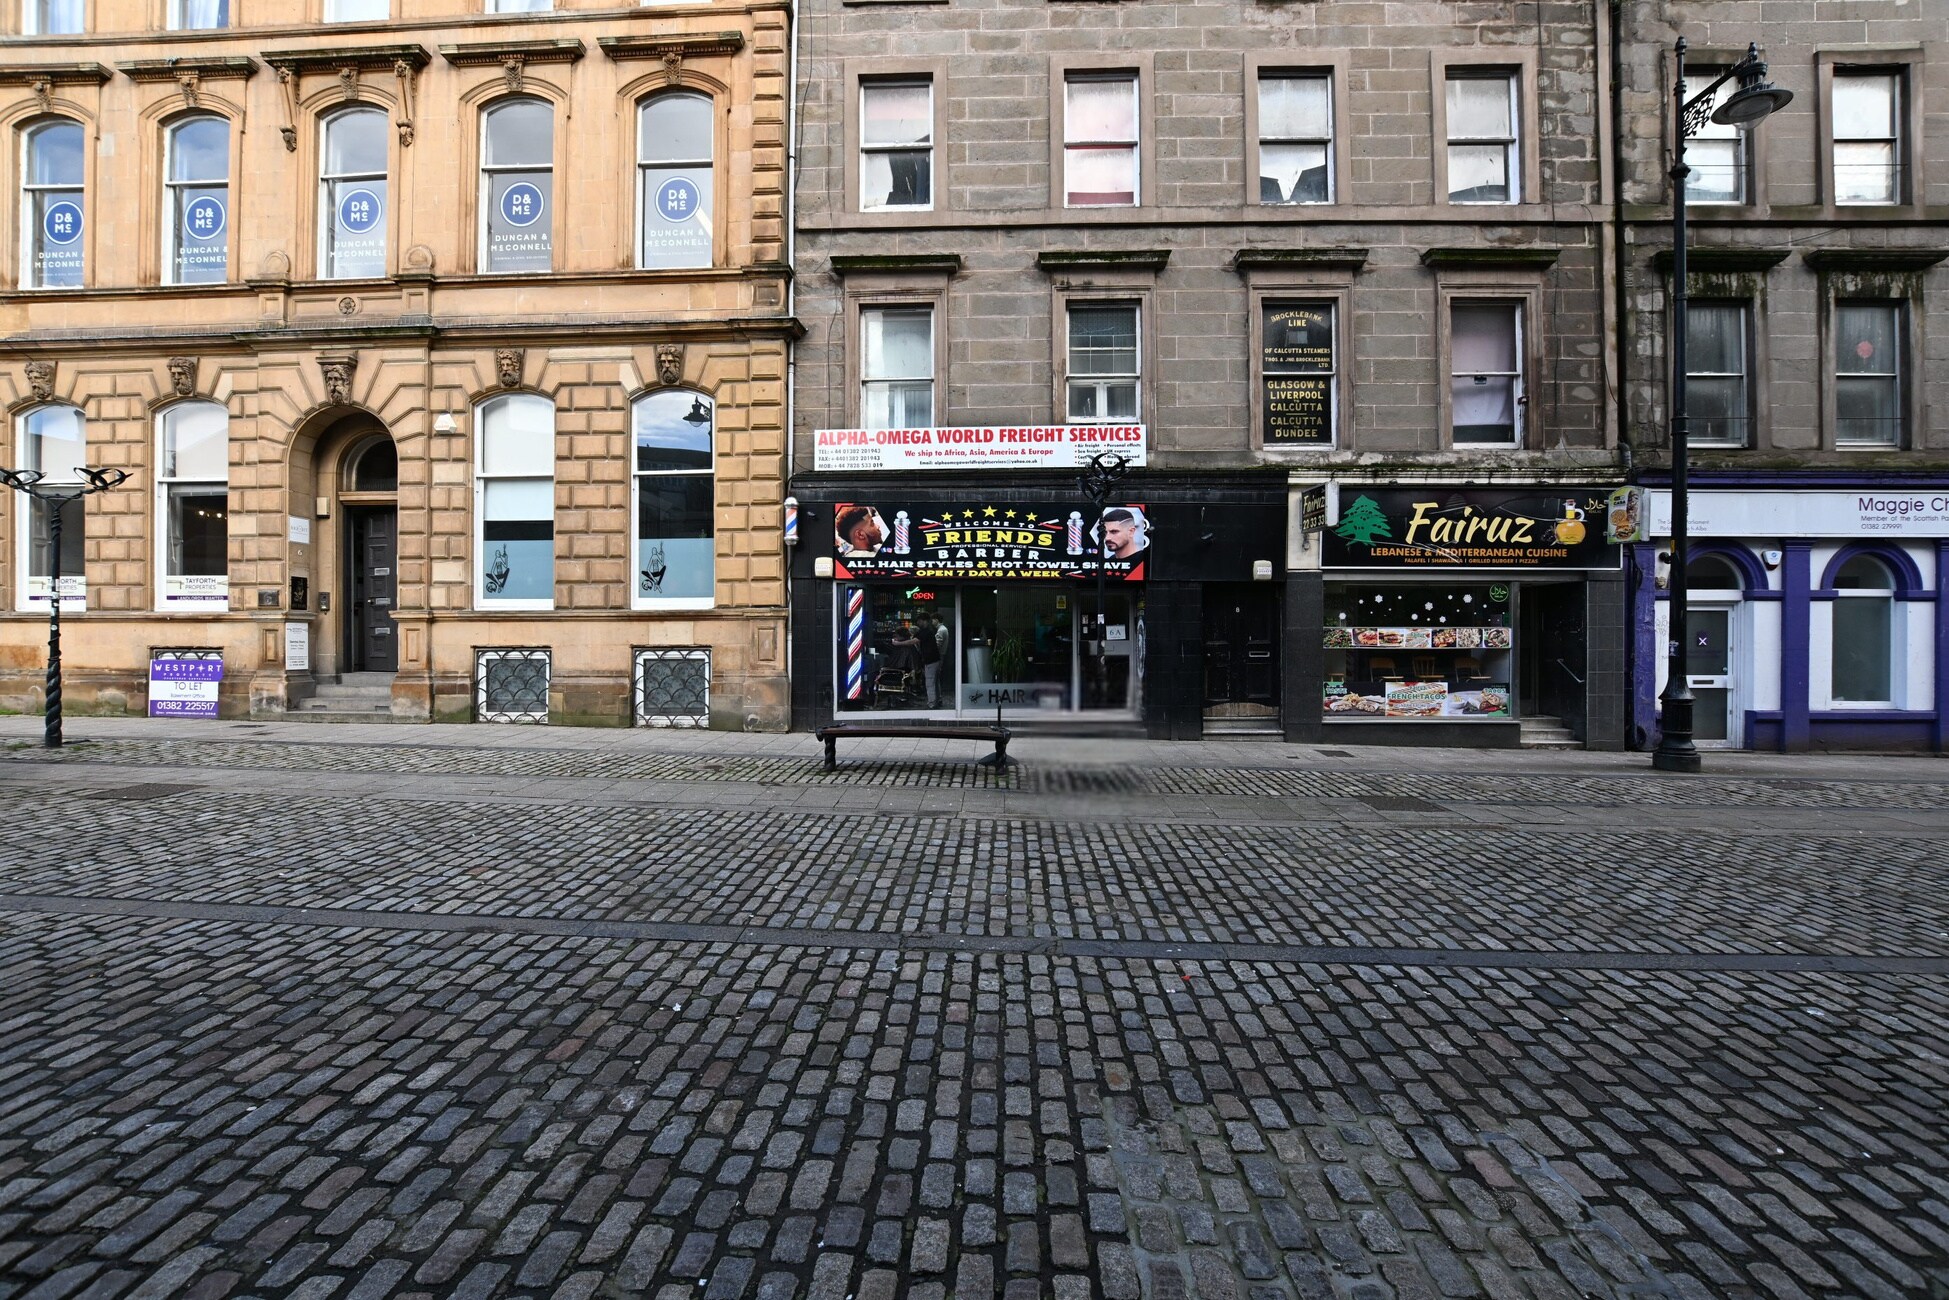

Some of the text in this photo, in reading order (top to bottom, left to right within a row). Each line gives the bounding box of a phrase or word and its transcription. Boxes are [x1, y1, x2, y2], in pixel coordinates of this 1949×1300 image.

[513, 194, 531, 204] D&
[669, 189, 687, 200] D&
[352, 201, 369, 211] D&
[196, 208, 214, 218] D&
[55, 213, 72, 223] D&
[651, 229, 693, 237] DUNCAN
[335, 240, 374, 248] DUNCAN
[180, 246, 219, 254] DUNCAN
[176, 256, 227, 264] McCONNEL
[1271, 311, 1323, 322] BROCKLEBANK
[1268, 381, 1325, 389] GLASGOW &
[1270, 391, 1323, 399] LIVERPOOL
[1270, 403, 1323, 411] CALCUTTA
[1270, 417, 1323, 425] CALCUTTA
[818, 427, 1141, 445] ALPHA-OMEGA WORLD FREIGHT SERVICES
[1275, 429, 1318, 437] DUNDEE
[944, 449, 967, 457] Africa,
[1028, 448, 1053, 456] Europe
[1303, 495, 1325, 514] Fairuz
[1584, 498, 1606, 510] حلال
[1859, 497, 1924, 514] Maggie
[944, 521, 1009, 529] WELCOME
[1303, 514, 1324, 530] 22 33 33
[1405, 502, 1535, 544] Fairuz
[925, 530, 1053, 546] FRIENDS
[938, 549, 1039, 560] BARBER
[1371, 548, 1568, 557] LEBANESE & MEDITERRANEAN CUISINE
[847, 560, 875, 568] ALL
[878, 560, 913, 568] HAIR
[917, 560, 973, 568] STYLES
[174, 682, 202, 690] TO LET
[989, 689, 1025, 703] HAIR
[185, 702, 215, 710] 225517
